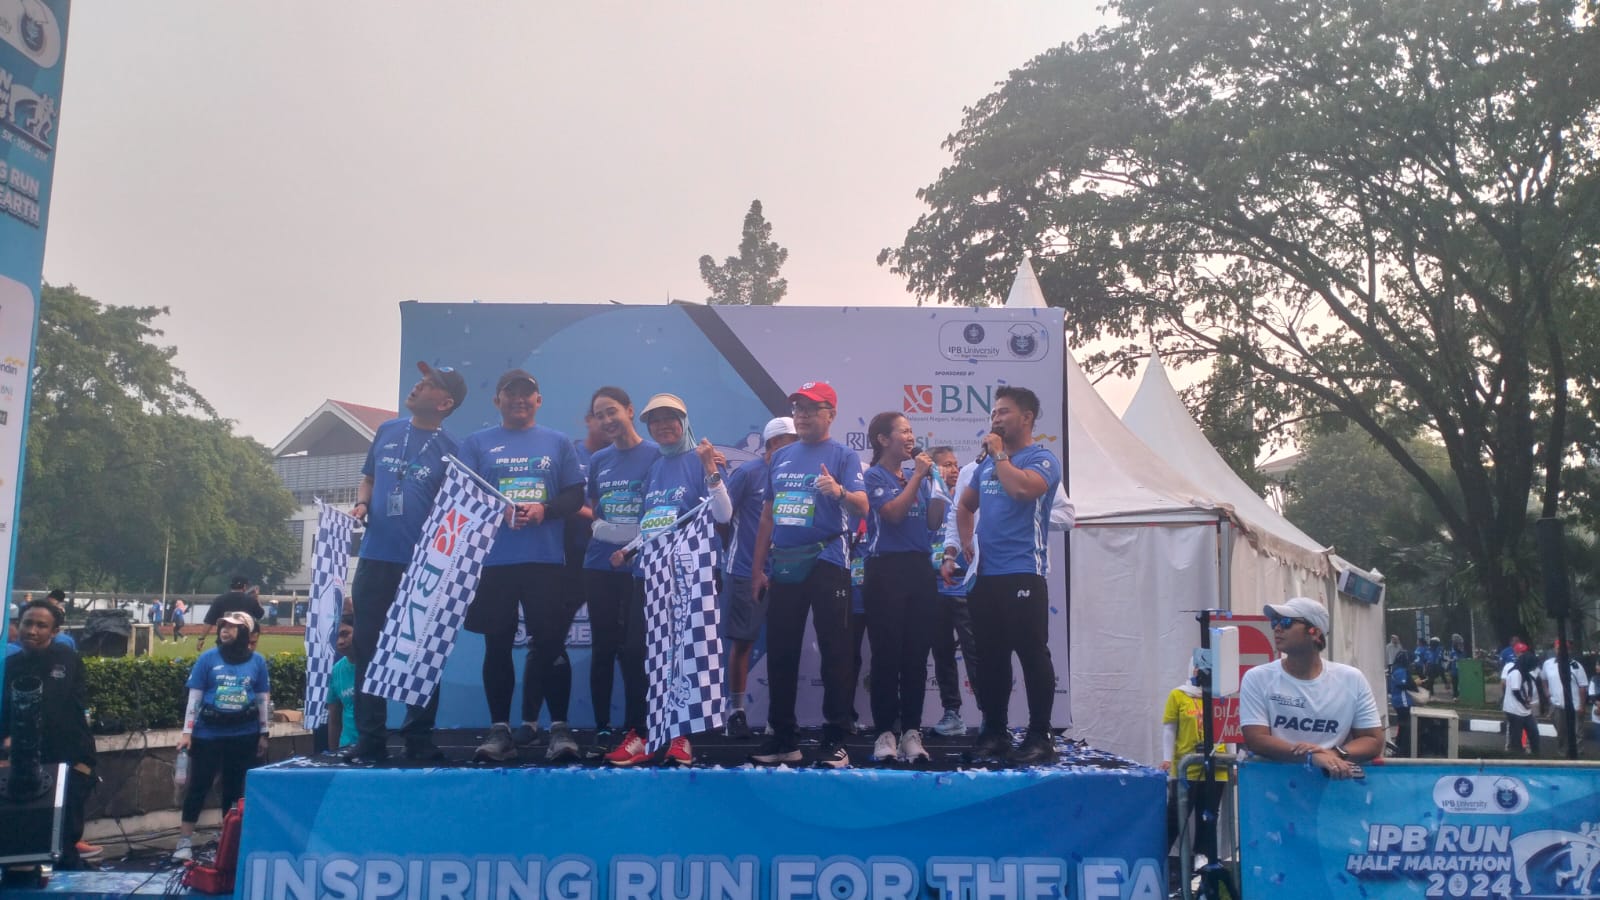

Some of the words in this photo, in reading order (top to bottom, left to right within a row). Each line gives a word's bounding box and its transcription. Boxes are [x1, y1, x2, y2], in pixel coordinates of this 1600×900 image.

[10, 167, 40, 194] RUN
[948, 345, 962, 354] IPB
[963, 345, 1000, 357] University
[940, 385, 993, 414] BN
[915, 436, 929, 449] SI
[612, 479, 630, 488] RUN
[505, 489, 543, 499] 51449
[604, 503, 641, 514] 51444
[776, 503, 809, 515] 51566
[1273, 715, 1339, 734] PACER
[1441, 799, 1456, 808] IPB
[1367, 824, 1429, 853] IPB
[1434, 825, 1511, 852] RUN
[1346, 854, 1401, 871] HALF
[1403, 855, 1512, 872] MARATHON
[250, 857, 593, 900] INSPIRING
[616, 860, 754, 900] RUN
[777, 861, 914, 900] FOR
[932, 862, 1063, 900] THE
[1082, 864, 1167, 900] EA
[1425, 873, 1512, 897] 2024
